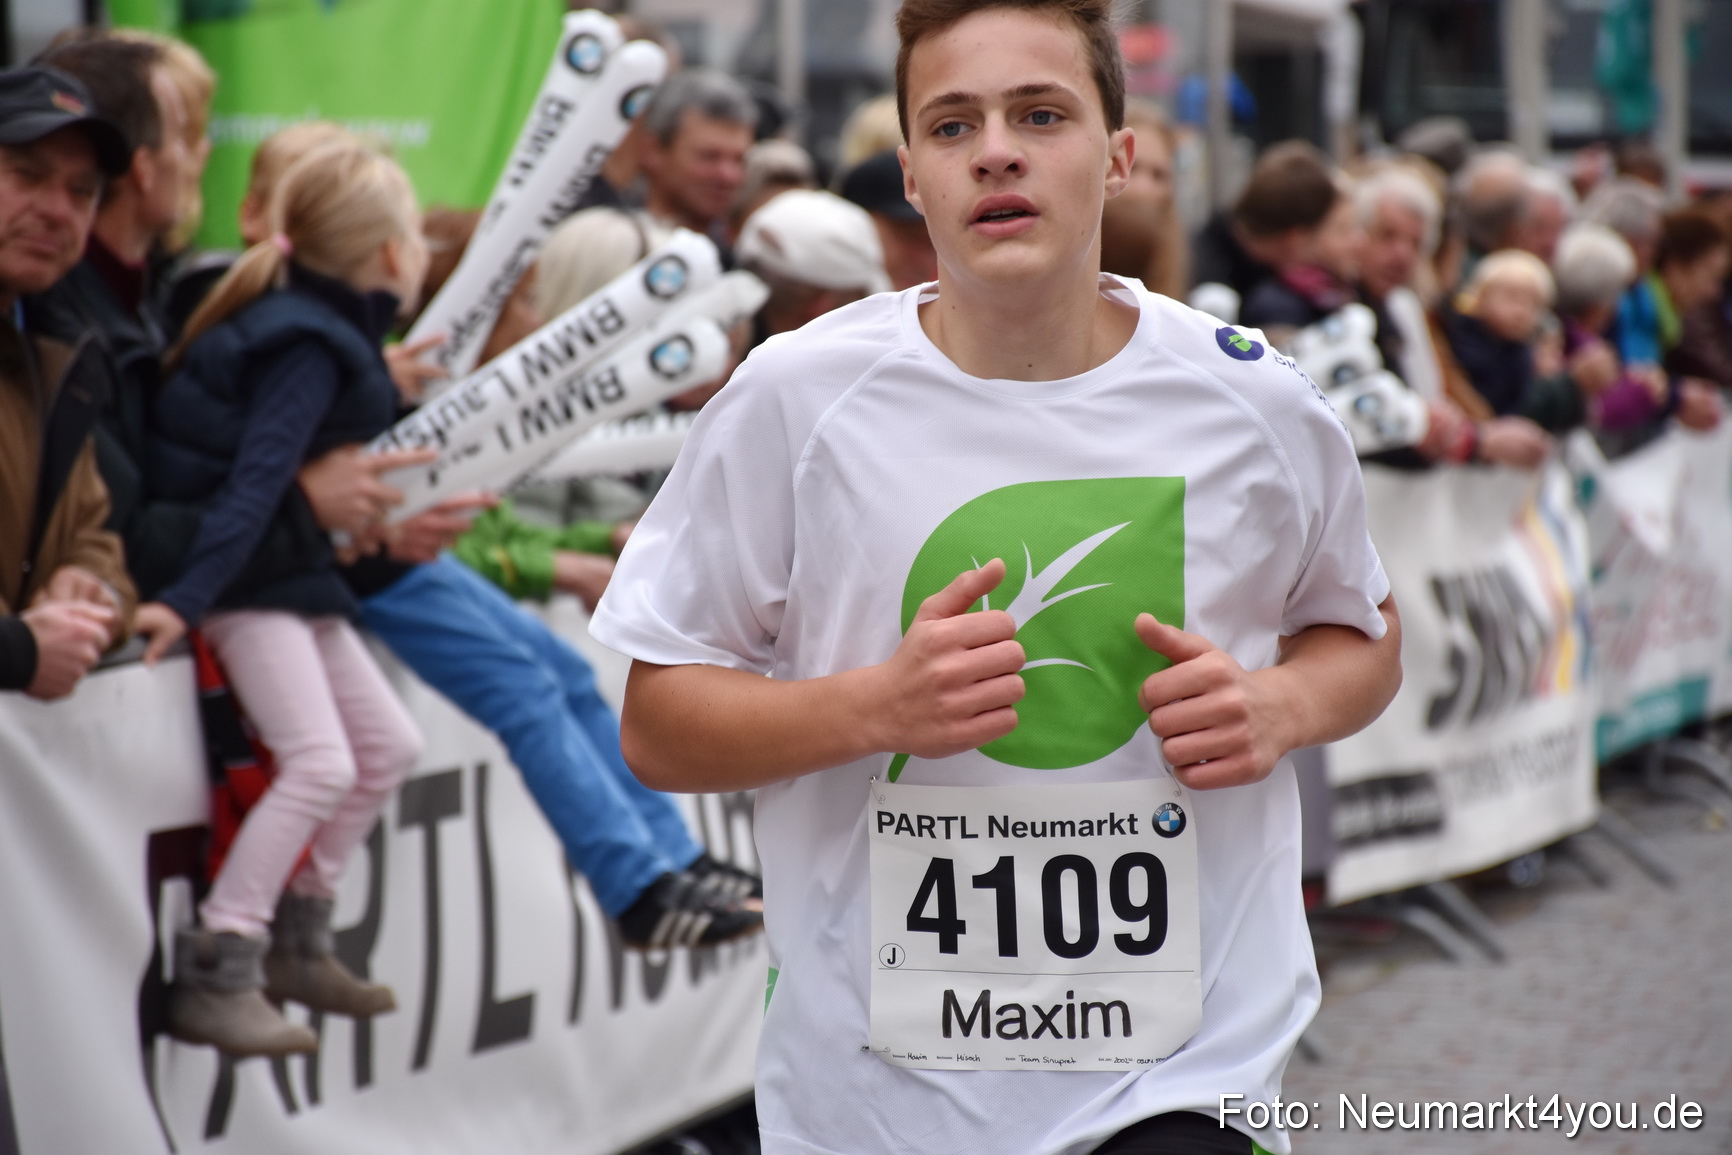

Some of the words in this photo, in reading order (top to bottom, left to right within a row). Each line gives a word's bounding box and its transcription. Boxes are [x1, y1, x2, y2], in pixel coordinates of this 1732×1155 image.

[520, 298, 627, 385] BMW
[518, 366, 626, 447] BMW
[877, 810, 979, 839] PARTL
[988, 812, 1139, 839] Neumarkt
[906, 852, 1168, 959] 4109
[886, 947, 897, 965] J
[941, 989, 1133, 1040] Maxim
[1018, 1054, 1041, 1064] Team
